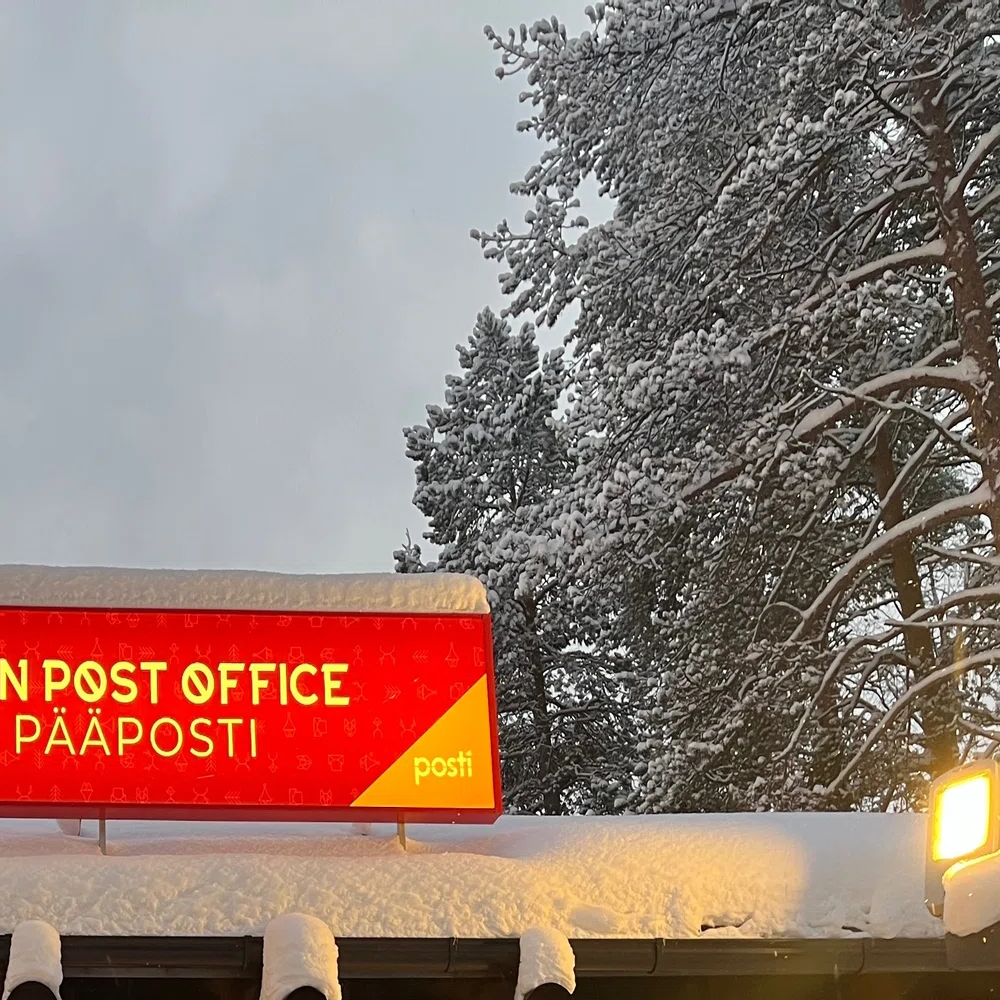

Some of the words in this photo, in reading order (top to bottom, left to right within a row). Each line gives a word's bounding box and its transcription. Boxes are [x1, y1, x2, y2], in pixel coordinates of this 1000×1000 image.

[42, 659, 167, 704] POST
[181, 662, 350, 706] OFFICE
[15, 707, 257, 758] PÄÄPOSTI
[413, 750, 473, 786] posti
